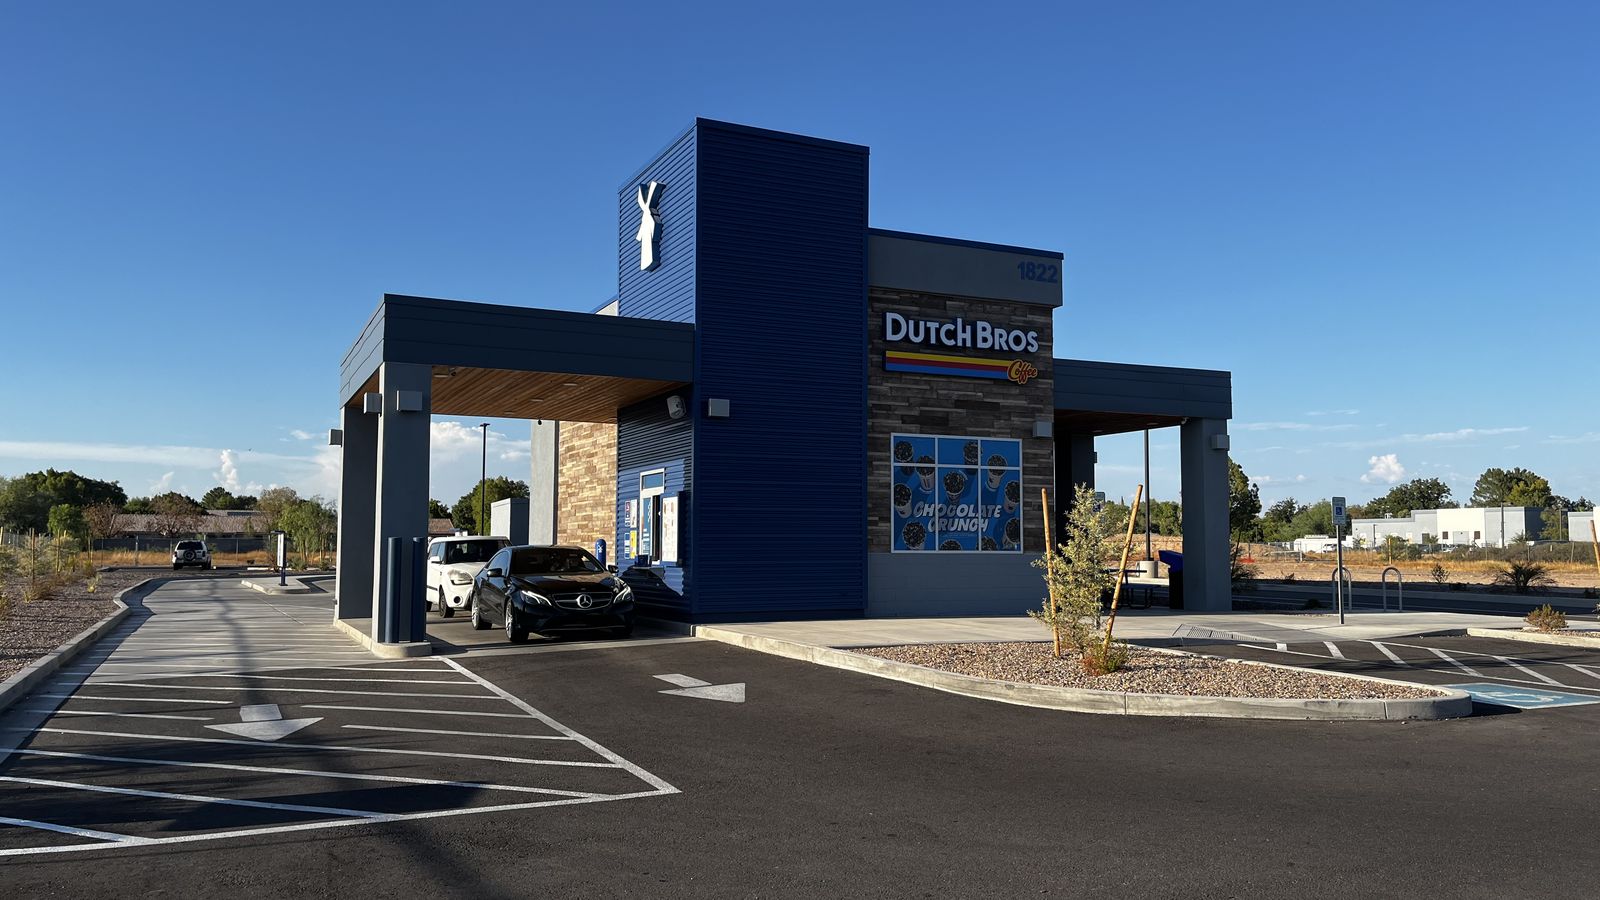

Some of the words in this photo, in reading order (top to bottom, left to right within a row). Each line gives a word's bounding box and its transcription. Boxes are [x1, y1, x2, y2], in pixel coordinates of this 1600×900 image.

[1017, 261, 1058, 283] 1822
[886, 312, 971, 348] DUTCH
[976, 321, 1039, 353] BROS
[1008, 360, 1038, 385] Coffee
[913, 501, 1003, 519] CHOCOLATE
[927, 518, 990, 533] CRUNCH
